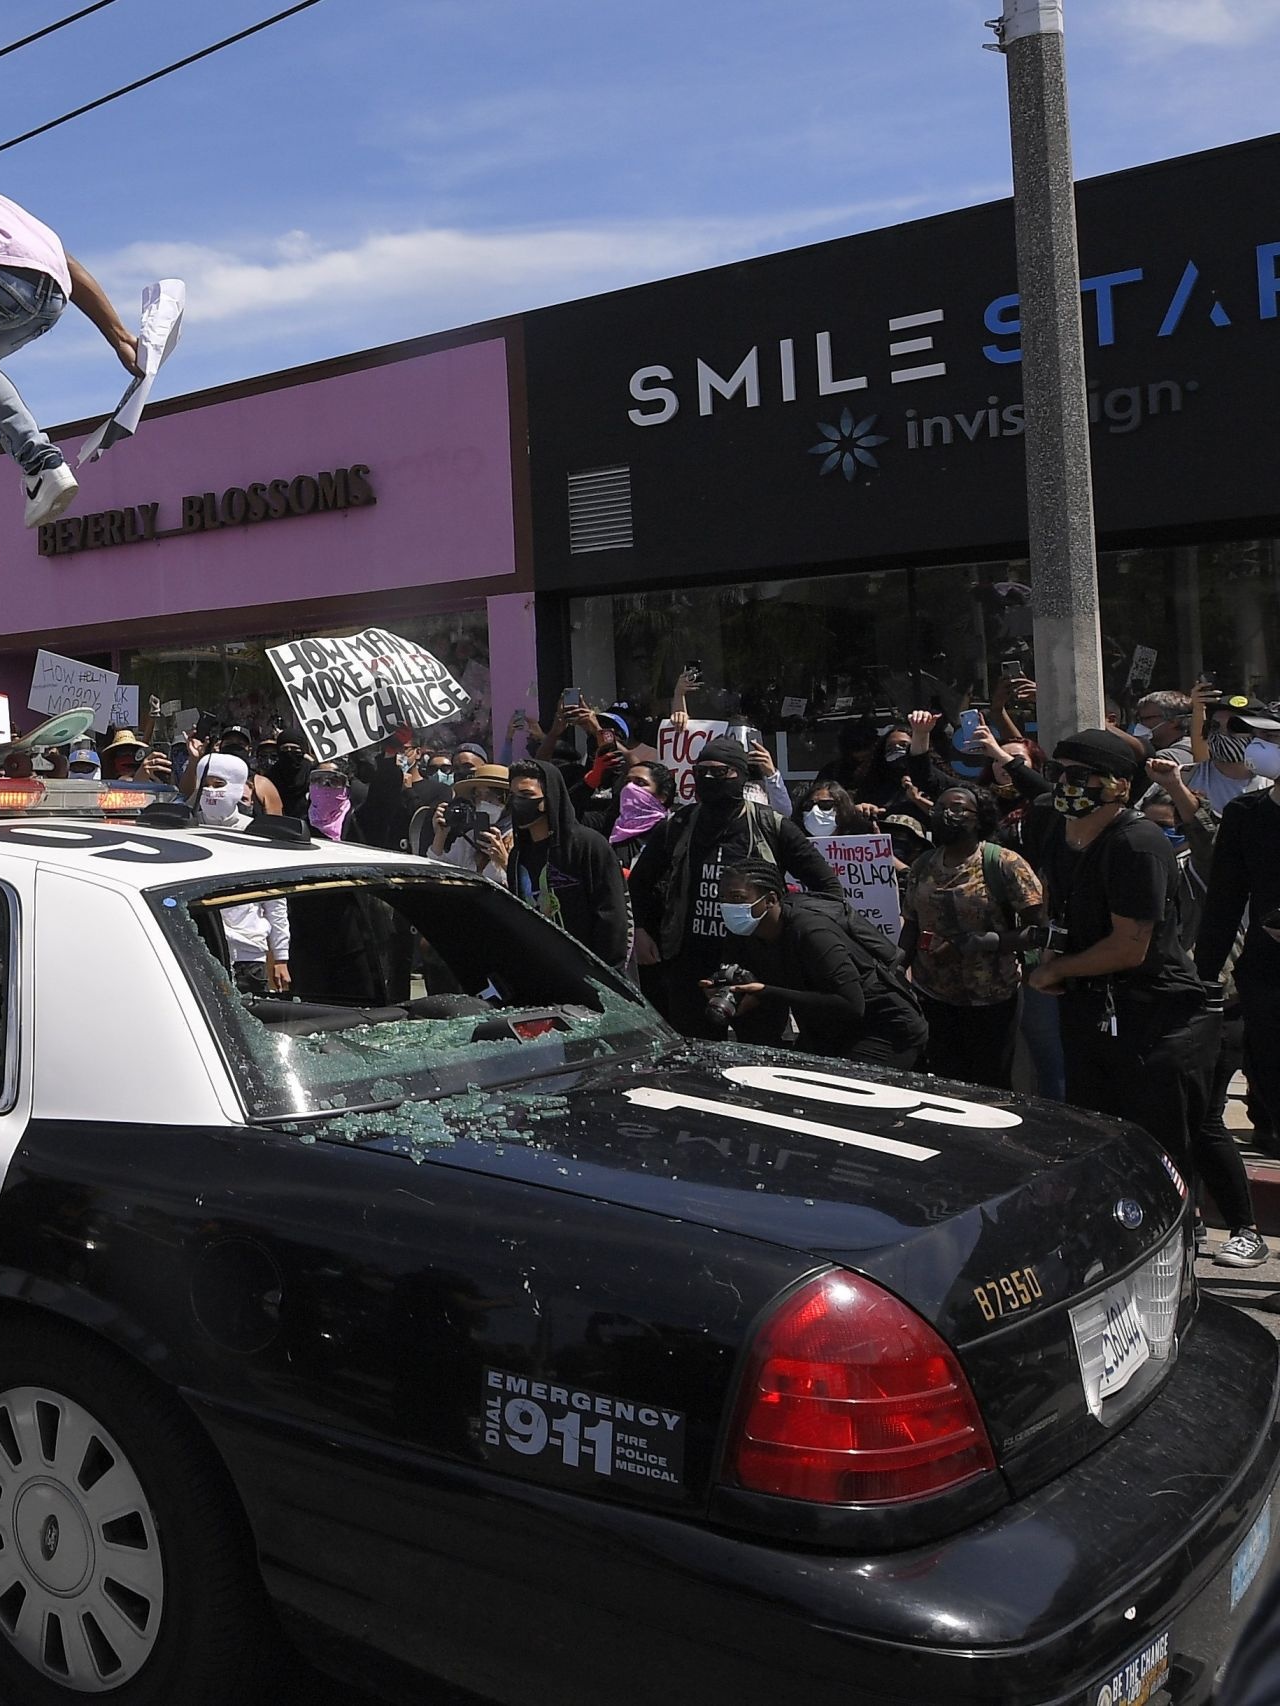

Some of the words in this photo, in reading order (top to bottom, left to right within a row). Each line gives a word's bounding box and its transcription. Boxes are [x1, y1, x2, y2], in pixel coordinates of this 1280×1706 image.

[628, 308, 946, 427] SMILE
[905, 378, 1183, 449] invisign
[38, 502, 160, 557] BEVERLY
[182, 464, 376, 532] BLOSSOMS
[41, 658, 75, 684] HOW
[270, 640, 348, 682] HOW
[288, 661, 372, 720] MORE
[358, 679, 470, 741] CHANGE
[825, 841, 874, 862] things
[870, 839, 892, 858] I'd
[847, 863, 897, 887] BLACK
[693, 918, 727, 937] BLAC
[974, 1267, 1043, 1322] 87950
[485, 1396, 501, 1446] DIAL
[487, 1370, 681, 1431] EMERGENCY
[616, 1432, 648, 1449] FIRE
[616, 1446, 668, 1467] POLICE
[615, 1459, 679, 1484] MEDICAL
[1112, 1672, 1123, 1702] BE
[1125, 1657, 1140, 1690] THE
[1140, 1632, 1169, 1678] CHANGE
